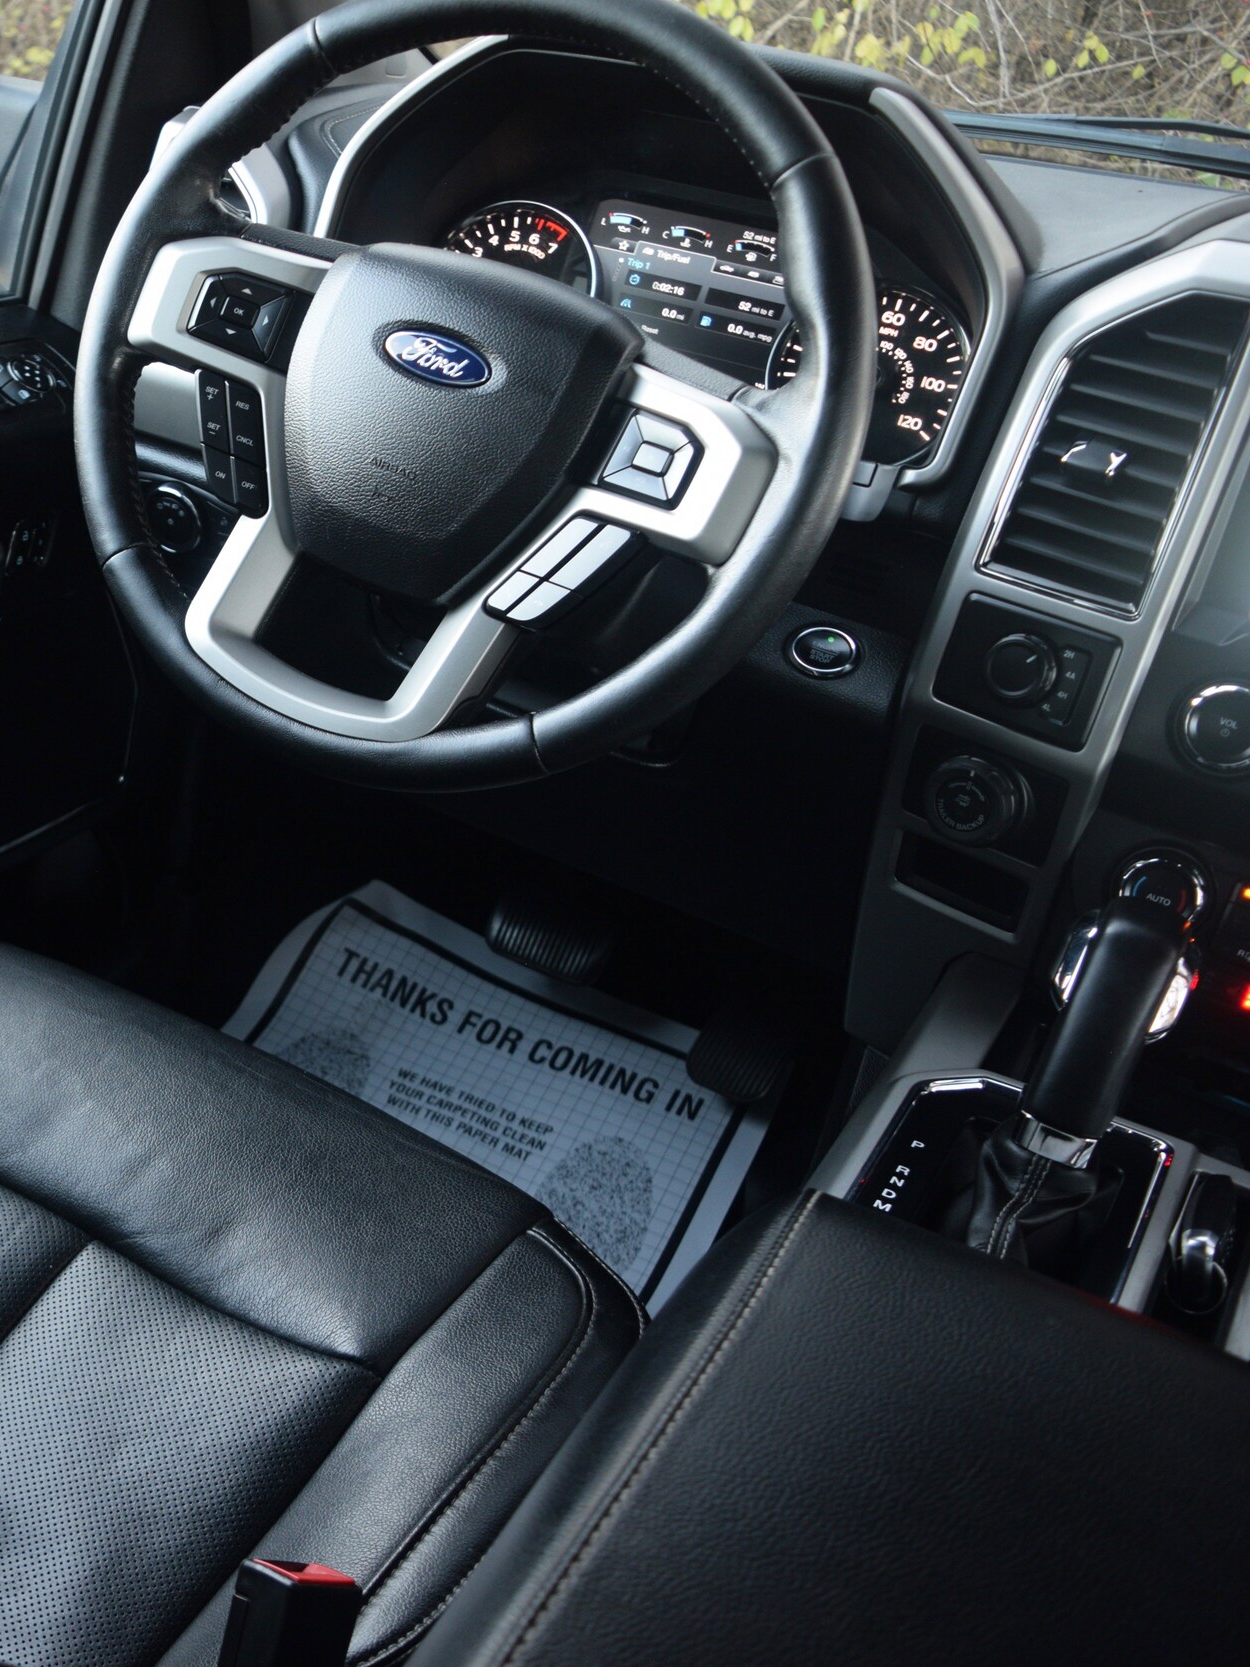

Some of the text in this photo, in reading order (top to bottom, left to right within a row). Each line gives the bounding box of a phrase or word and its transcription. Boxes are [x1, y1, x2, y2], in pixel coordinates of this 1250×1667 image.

[600, 217, 607, 226] L
[509, 230, 521, 242] 5
[641, 226, 650, 235] H
[662, 230, 670, 240] C
[488, 234, 500, 246] 4
[528, 233, 541, 245] 6
[742, 230, 755, 241] 52
[769, 236, 777, 245] E
[503, 243, 522, 252] RPM
[547, 242, 559, 255] 7
[705, 240, 713, 249] H
[726, 244, 734, 253] E
[471, 246, 484, 258] 3
[657, 249, 691, 265] Trip/Fuel
[769, 253, 778, 262] F
[627, 257, 651, 270] Trip 1
[651, 280, 685, 296] 0:02:16
[232, 306, 245, 317] OK
[661, 307, 685, 321] 0.0 mi
[738, 300, 752, 312] 52
[751, 306, 760, 314] mi
[767, 308, 775, 318] E
[881, 311, 906, 327] 60
[727, 323, 743, 335] 0.0
[757, 333, 773, 343] mpg
[878, 326, 899, 338] MPH
[912, 335, 938, 352] 80
[401, 336, 471, 379] Ford
[919, 375, 946, 393] 100
[205, 385, 220, 396] SET
[235, 400, 250, 411] RES
[206, 421, 222, 432] SET
[896, 414, 923, 432] 120
[235, 434, 254, 447] CNCL
[214, 470, 227, 480] ON
[241, 480, 256, 491] OFF
[1063, 649, 1075, 659] 2H
[1065, 671, 1076, 680] 4A
[1056, 690, 1068, 700] 4H
[1219, 716, 1238, 730] VOL
[937, 798, 985, 831] TRAILER BACKUP
[1146, 893, 1172, 907] AUTO
[337, 947, 705, 1121] THANKS FOR COMING IN
[398, 1067, 554, 1137] WE HAVE TRIED TO KEEP
[389, 1079, 547, 1151] YOUR CARPETING CLEAN
[386, 1093, 533, 1162] WITH THIS PAPER MAT
[910, 1139, 925, 1148] P
[895, 1164, 911, 1176] R
[889, 1175, 905, 1188] N
[881, 1187, 897, 1199] D
[872, 1198, 893, 1212] M
